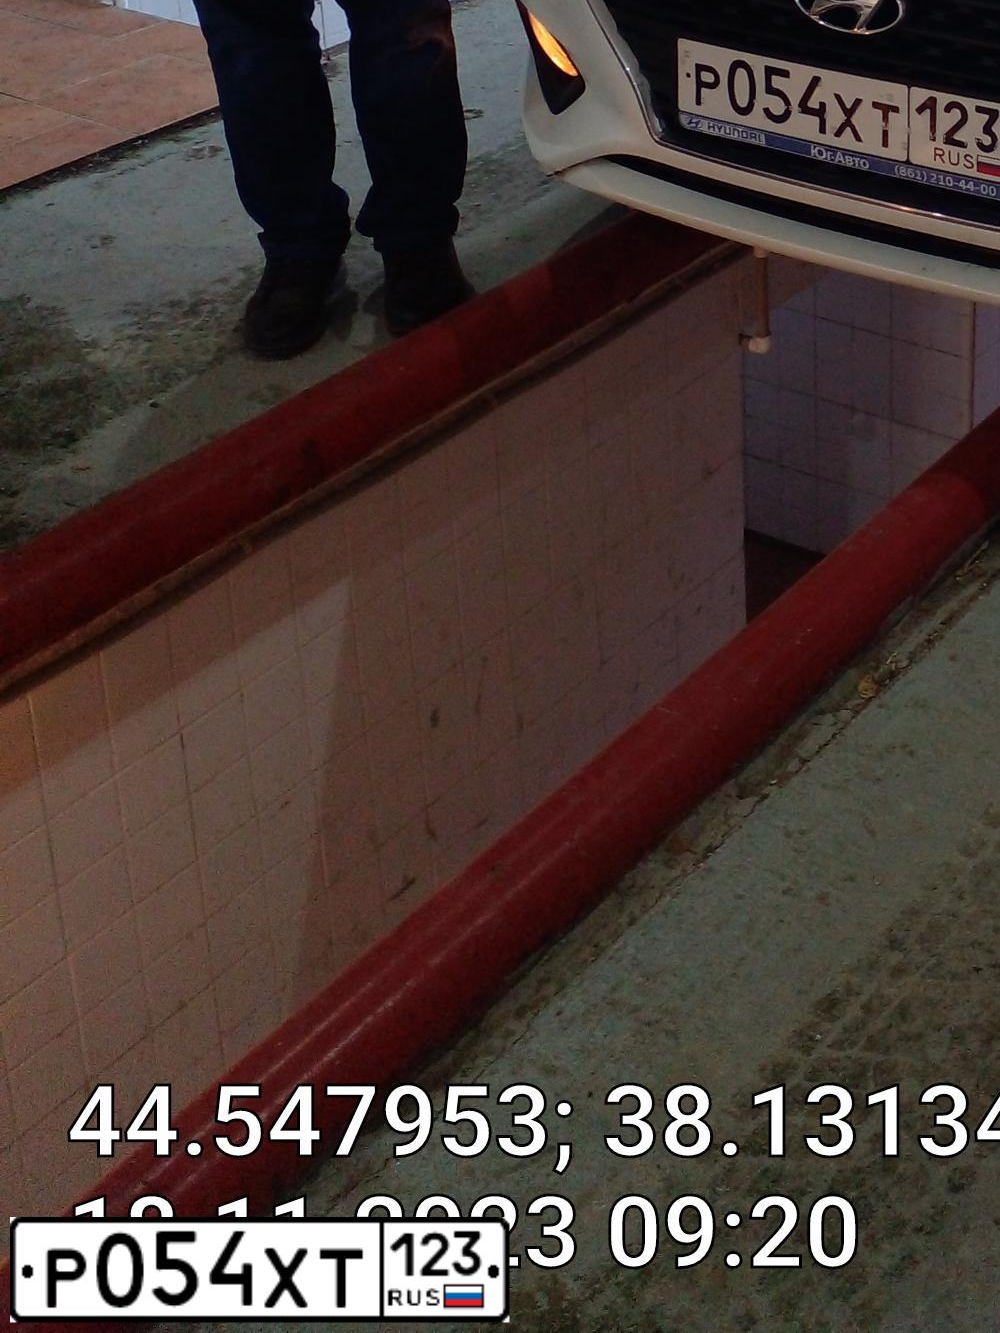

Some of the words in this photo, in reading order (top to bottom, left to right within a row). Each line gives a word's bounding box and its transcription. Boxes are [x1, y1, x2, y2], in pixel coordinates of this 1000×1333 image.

[707, 121, 764, 145] HYUNDAI
[915, 96, 1000, 153] 123
[933, 147, 975, 170] RUS
[894, 164, 928, 183] (861)
[930, 173, 997, 197] 210-44-00
